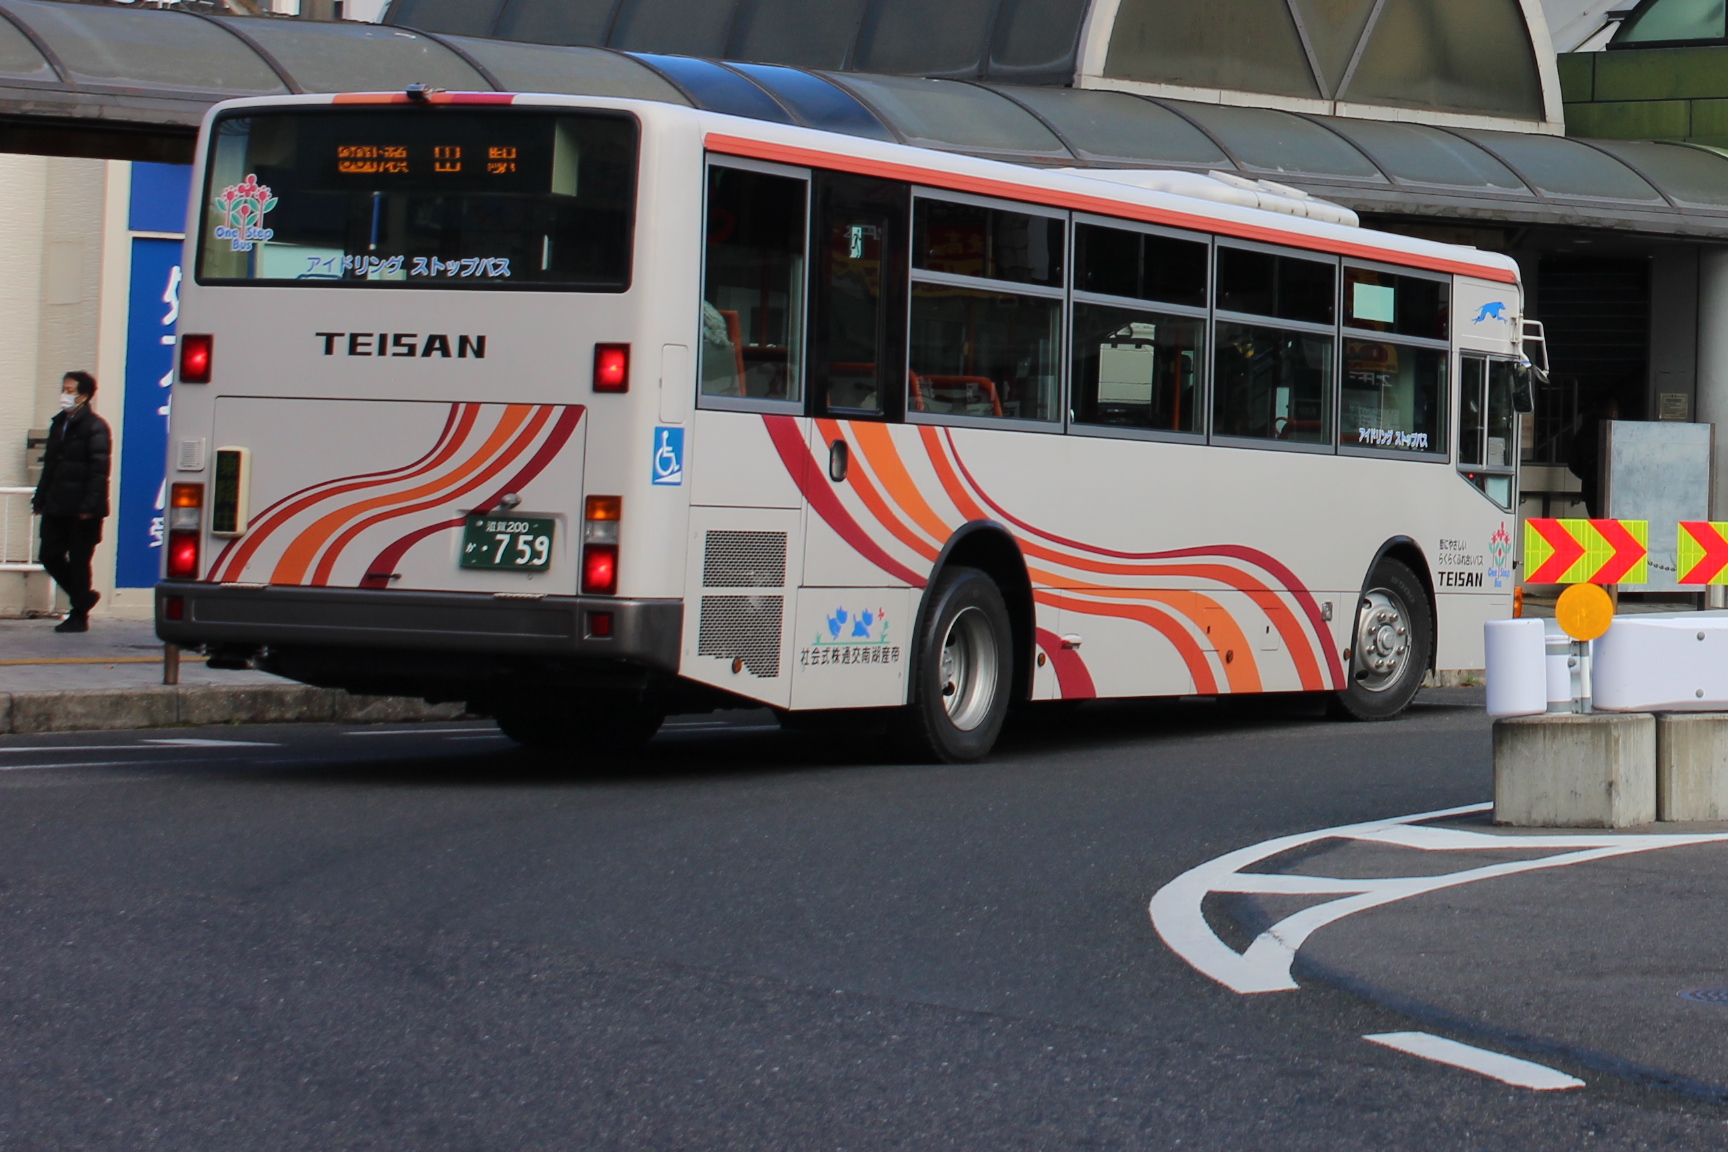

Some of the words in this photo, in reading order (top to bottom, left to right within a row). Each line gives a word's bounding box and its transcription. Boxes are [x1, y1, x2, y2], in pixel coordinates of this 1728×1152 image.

[215, 226, 239, 238] One
[246, 226, 274, 242] Step
[232, 238, 253, 251] Bus
[306, 255, 405, 275] アイドリング
[410, 256, 511, 277] ストップバス
[315, 332, 487, 359] TEISAN
[1438, 571, 1483, 588] TEISAN
